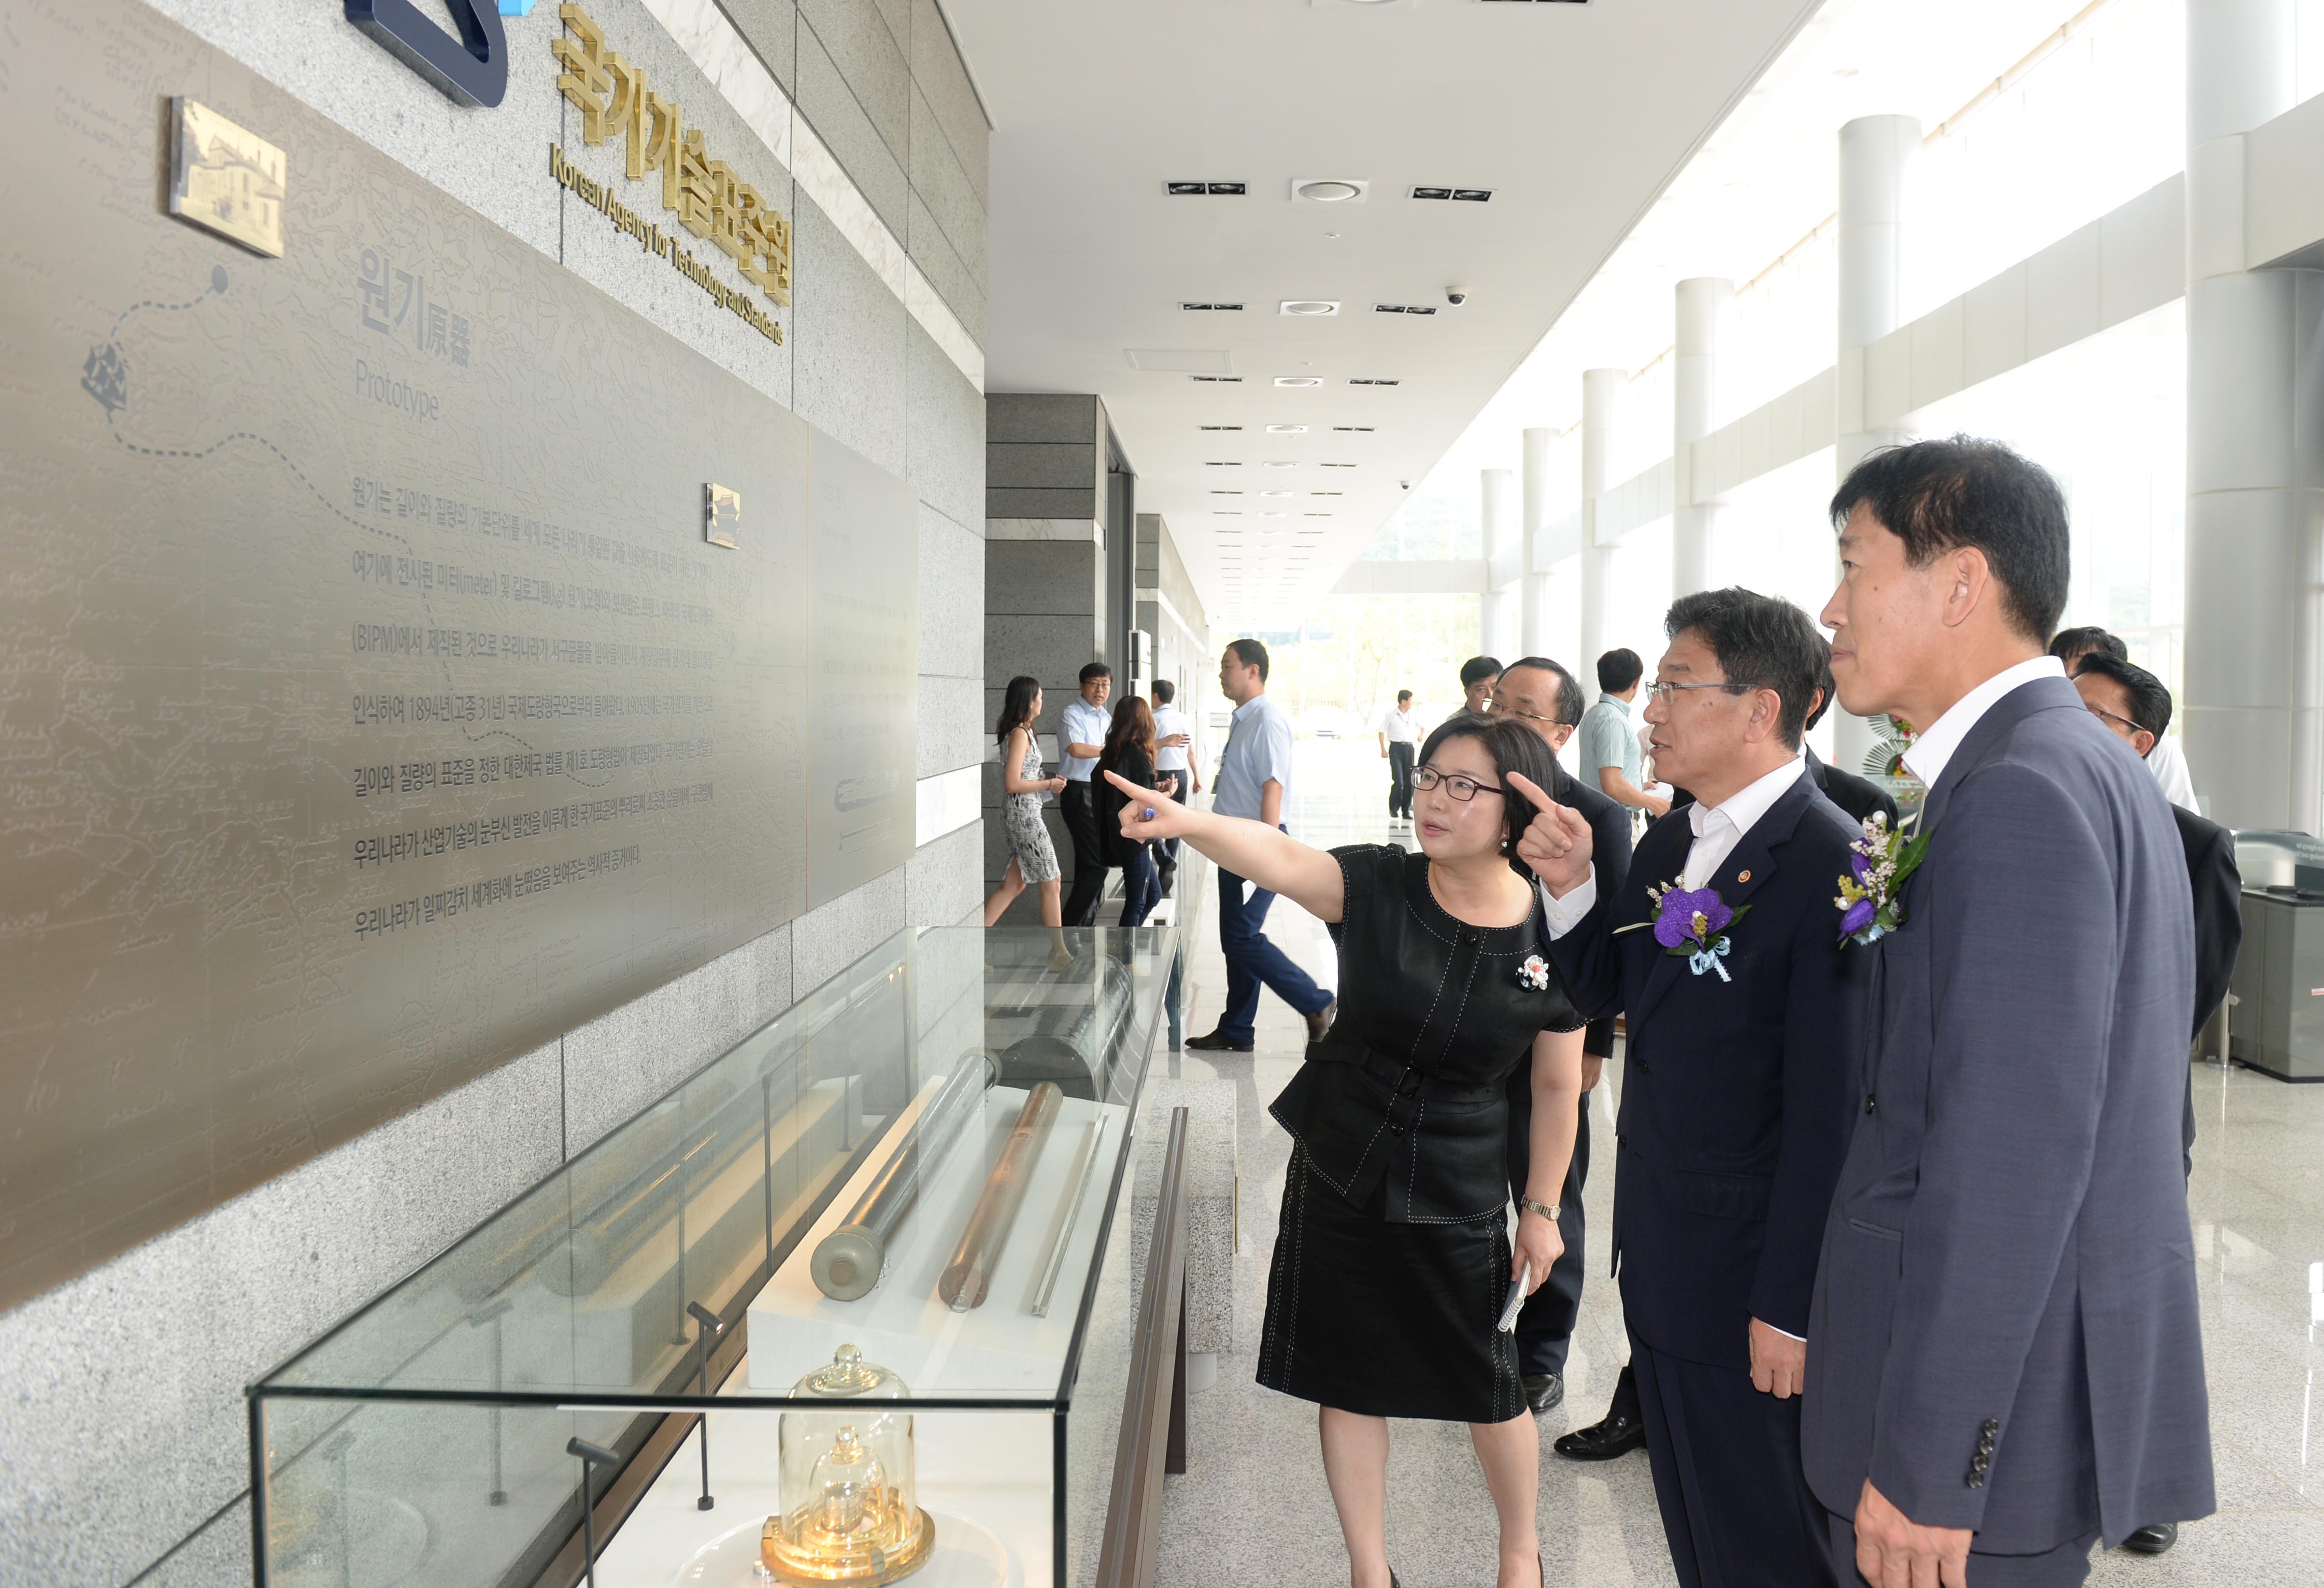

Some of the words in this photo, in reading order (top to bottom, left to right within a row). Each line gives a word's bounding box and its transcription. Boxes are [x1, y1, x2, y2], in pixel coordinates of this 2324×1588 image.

[552, 3, 790, 307] 국가기술표준원
[550, 142, 604, 211] Korean
[606, 188, 653, 252] Agency
[652, 224, 671, 259] for
[671, 237, 728, 308] Technology
[728, 287, 744, 317] and
[744, 296, 783, 346] Standards
[356, 359, 439, 423] Prototype
[353, 477, 391, 514] 원기는
[396, 488, 431, 523] 길이와
[435, 497, 467, 531] 질량의
[472, 506, 519, 541] 기본단위를
[543, 524, 560, 550] 모든
[353, 550, 392, 584] 여기에
[397, 557, 433, 589] 전시된
[437, 564, 497, 597] 미터(meter)
[501, 574, 510, 599] 및
[353, 621, 422, 656] (BIPM)에서
[427, 629, 462, 657] 제작된
[467, 633, 497, 657] 것으로
[502, 635, 548, 662] 우리나라가
[551, 638, 592, 664] 서구문물을
[353, 695, 404, 724] 인식하여
[409, 694, 476, 723] 1894년(고종
[478, 694, 506, 721] 31년)
[508, 695, 592, 720] 국제도량형국으로부터
[594, 695, 625, 718] 들여왔다.
[626, 695, 662, 716] 1905년에는
[354, 765, 394, 797] 길이와
[400, 762, 436, 793] 질량의
[441, 759, 475, 786] 표준을
[479, 755, 500, 784] 정한
[504, 753, 542, 780] 대한제국
[546, 752, 563, 776] 법률
[566, 749, 588, 773] 제1호
[591, 745, 627, 770] 도량형법이
[354, 831, 419, 869] 우리나라가
[422, 821, 477, 857] 산업기술의
[480, 815, 510, 845] 눈부신
[514, 811, 540, 839] 발전을
[544, 808, 568, 832] 이루게
[571, 804, 579, 828] 한
[580, 798, 617, 825] 국가표준의
[647, 790, 665, 812] 소중한
[355, 898, 420, 941] 우리나라가
[423, 886, 468, 923] 일찌감치
[472, 875, 512, 908] 세계화에
[514, 866, 550, 897] 눈떴음을
[553, 857, 586, 885] 보여주는
[588, 851, 610, 876] 역사적
[612, 843, 641, 871] 증거이다.
